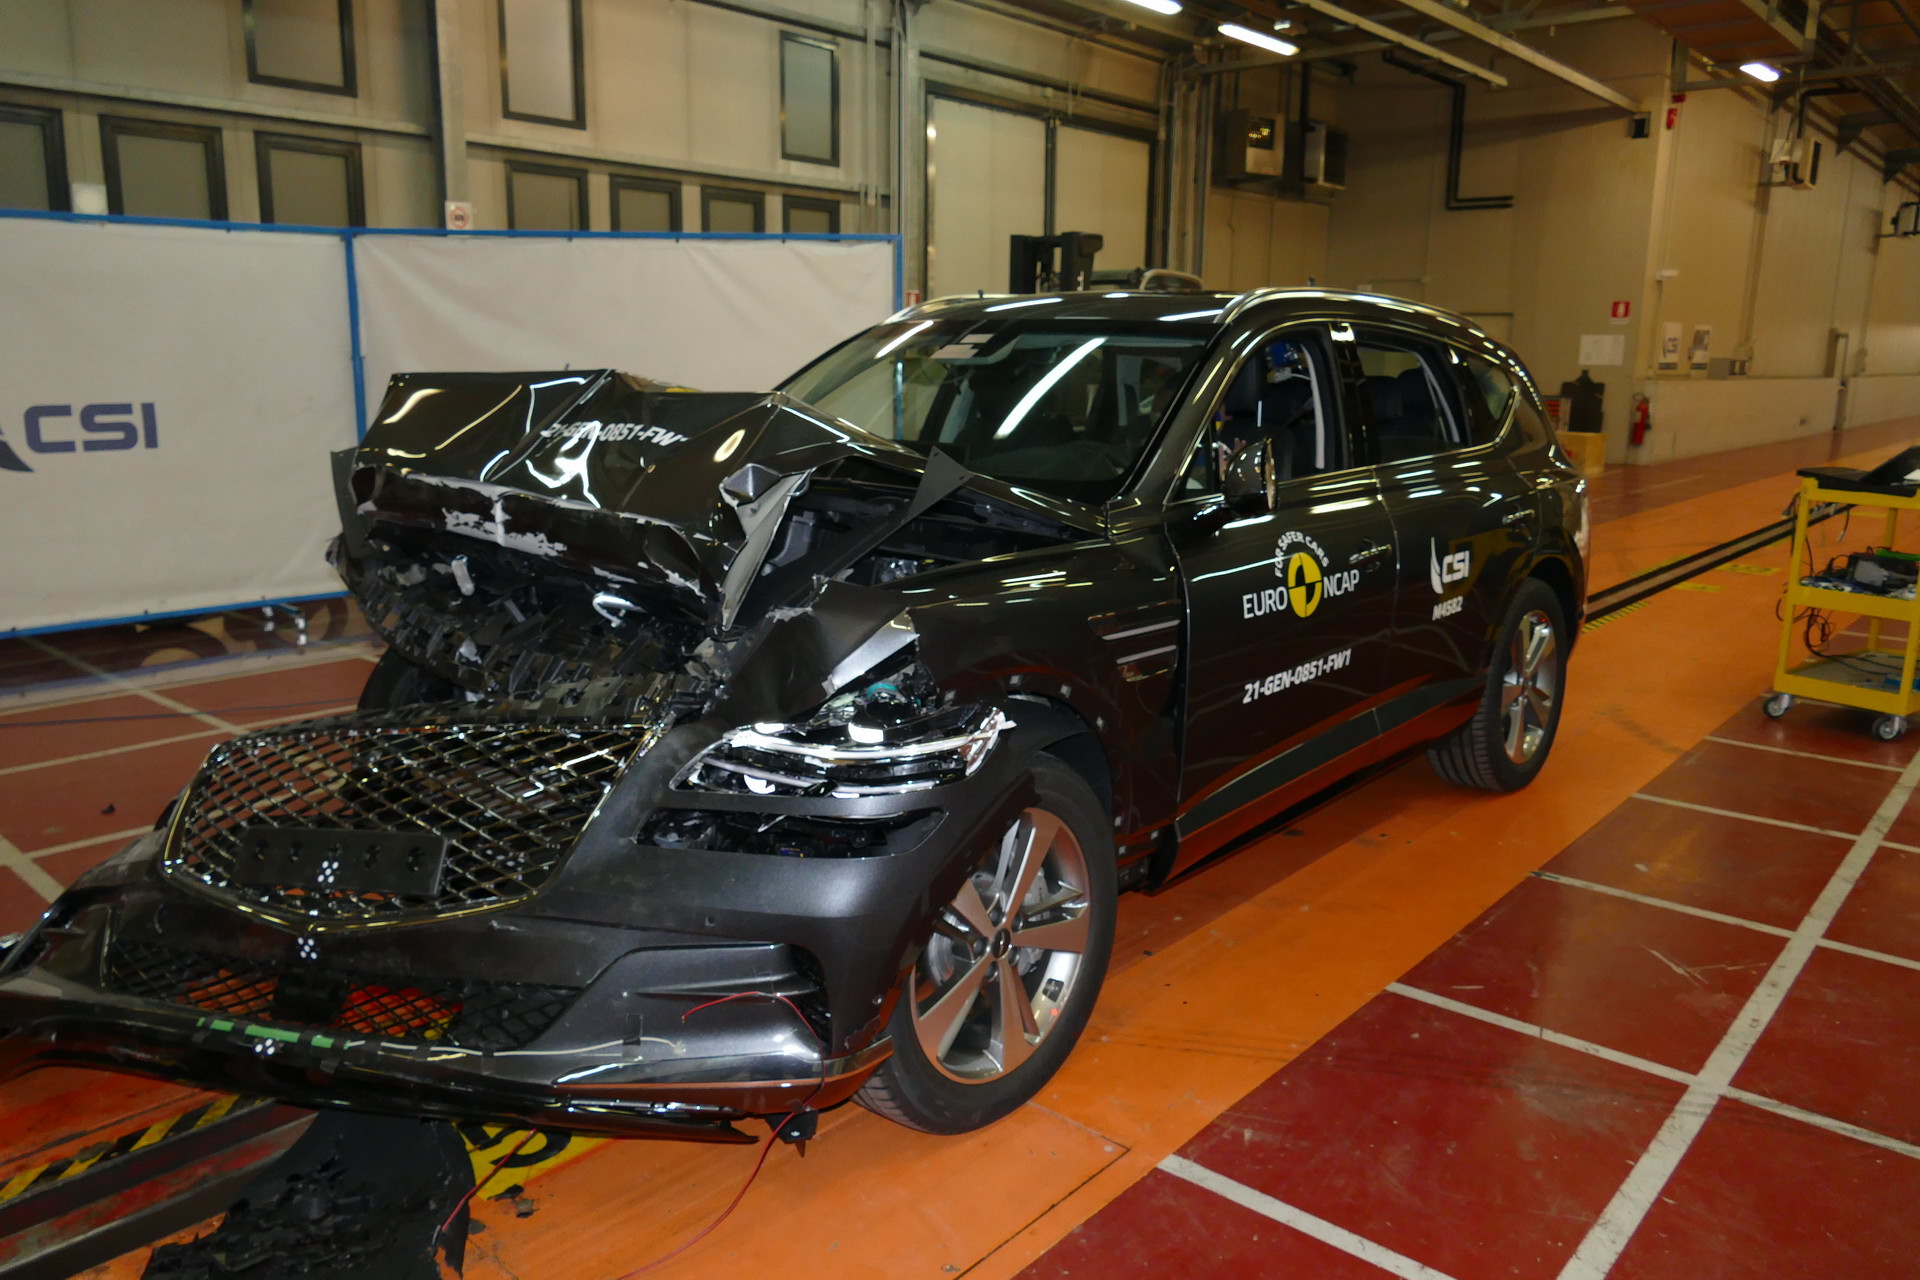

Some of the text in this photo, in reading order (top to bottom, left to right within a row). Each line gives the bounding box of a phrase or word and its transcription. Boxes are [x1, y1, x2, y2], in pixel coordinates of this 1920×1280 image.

[24, 402, 158, 454] CSI
[1275, 531, 1329, 578] FOR SAFER CARS
[1442, 550, 1470, 584] CSI
[1242, 569, 1360, 619] EURO NCAP
[1242, 648, 1352, 704] 21-GEN-0851-FW1
